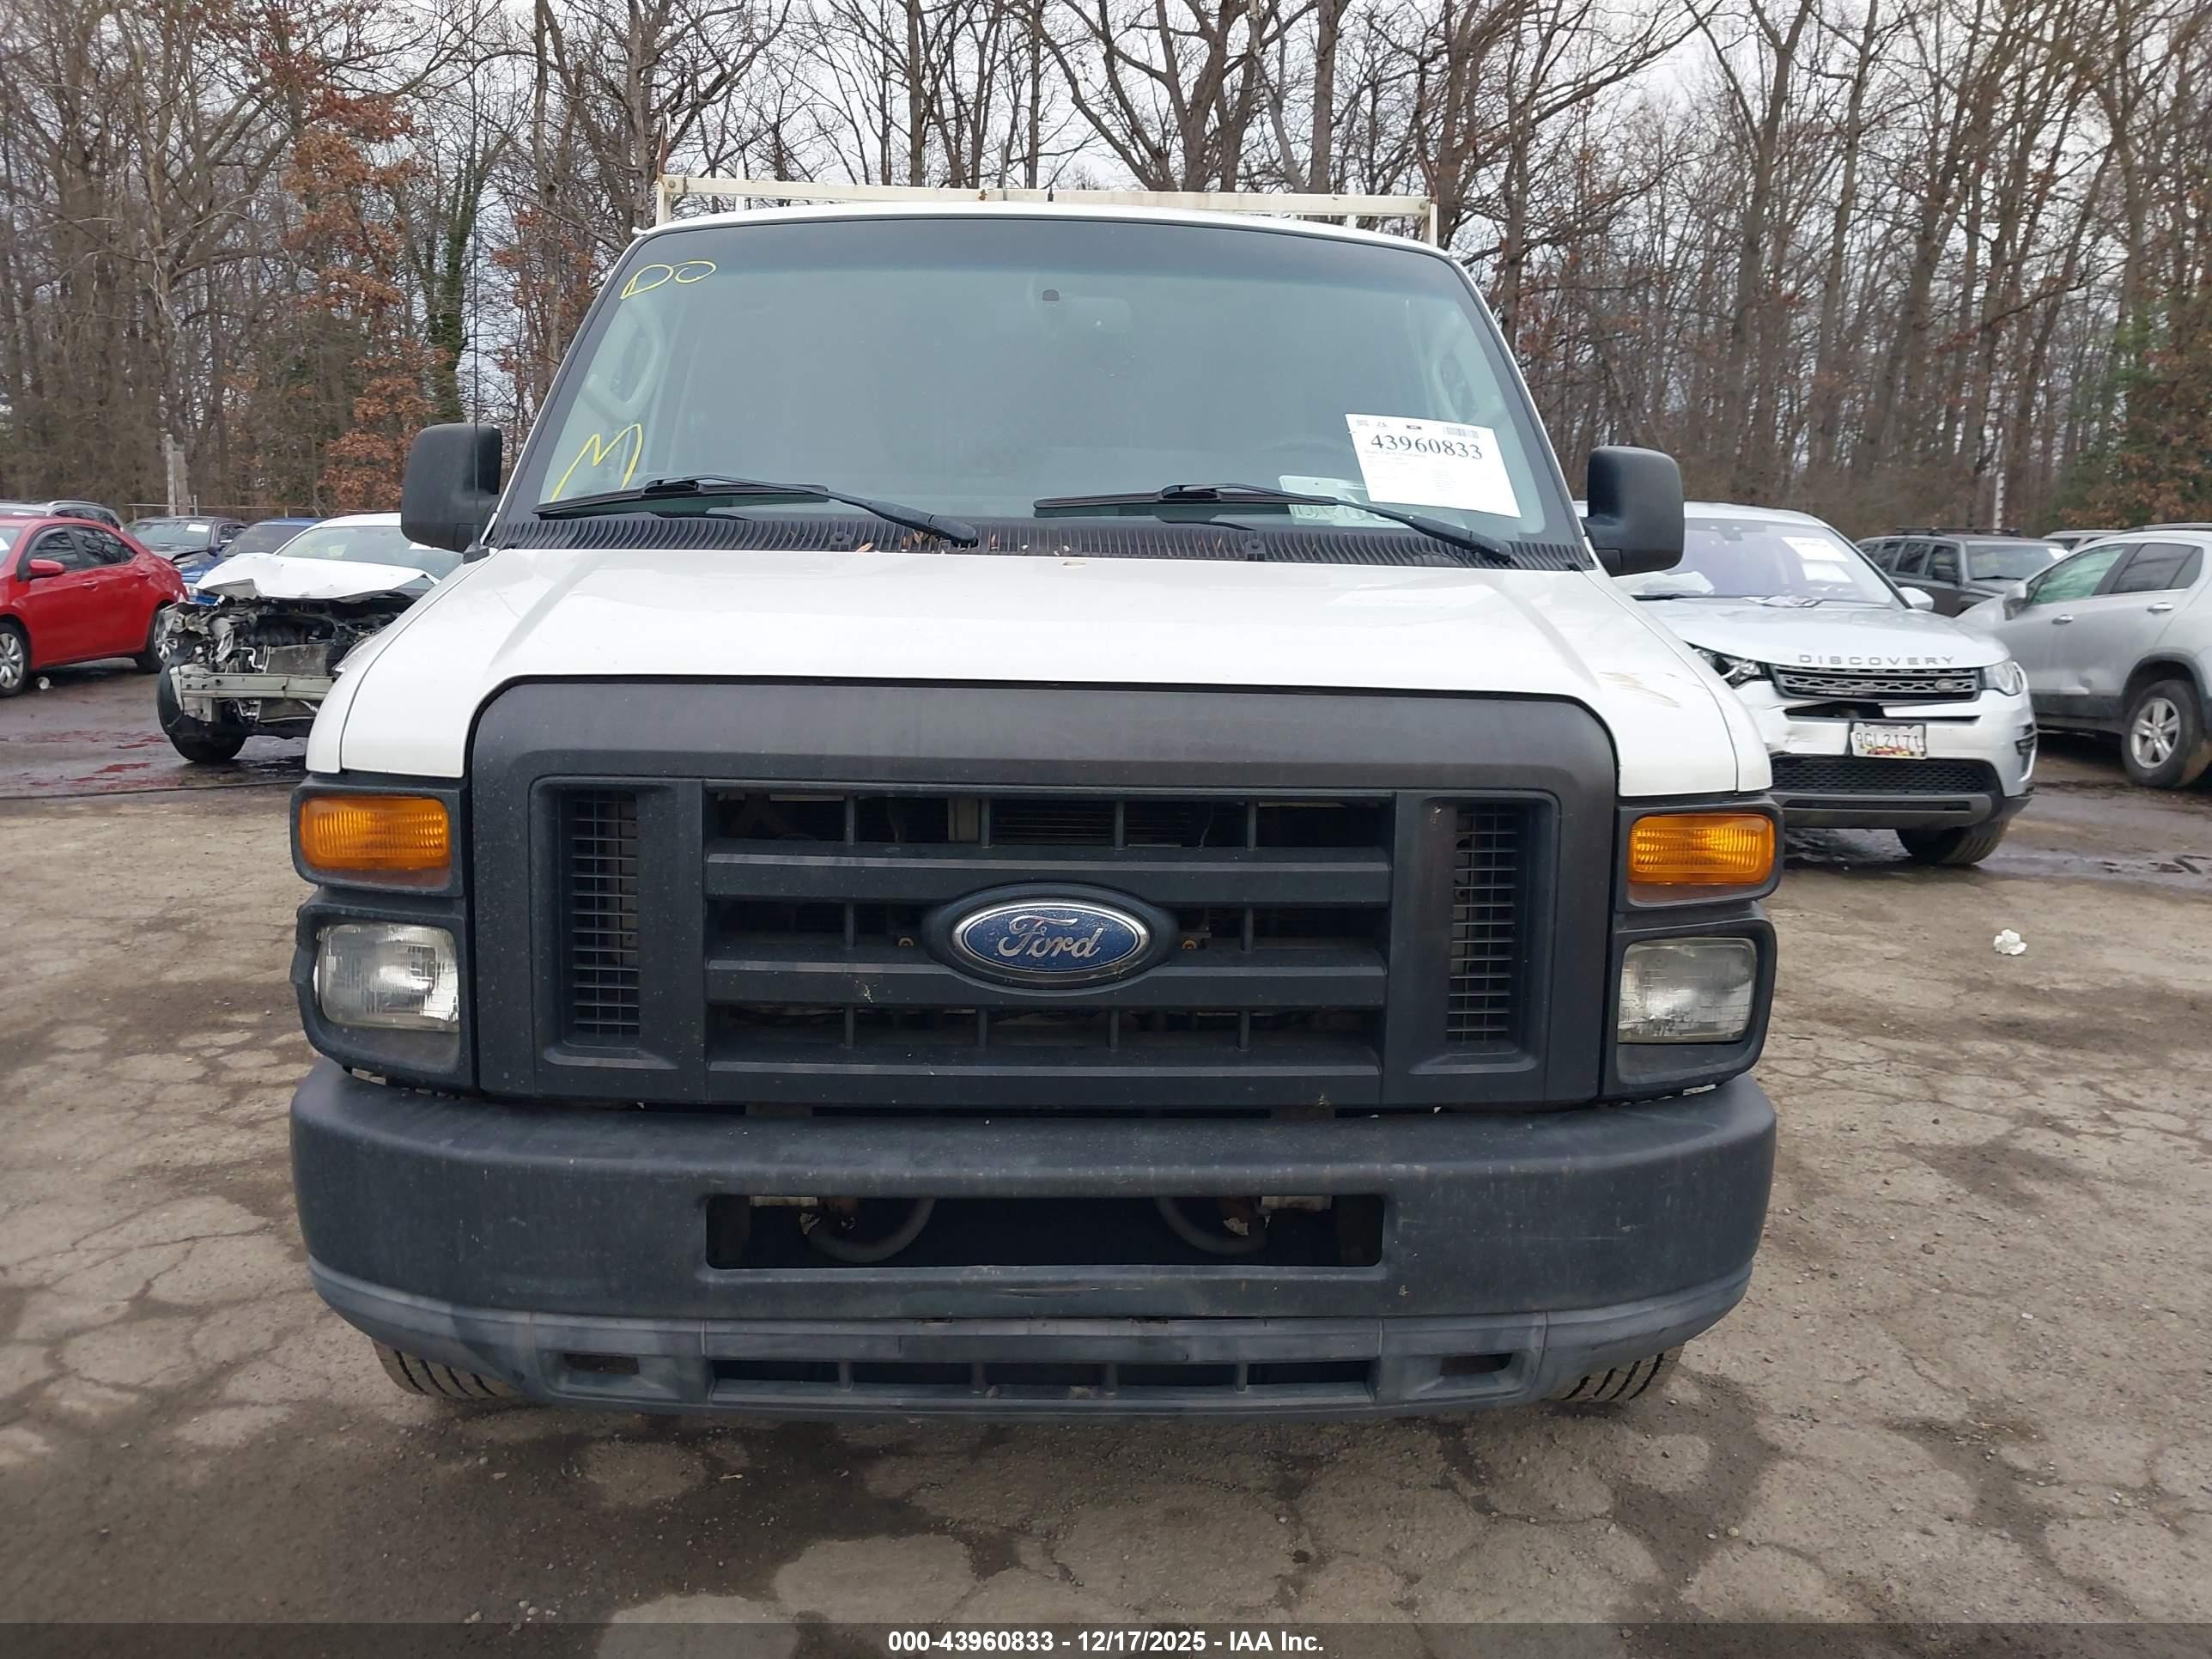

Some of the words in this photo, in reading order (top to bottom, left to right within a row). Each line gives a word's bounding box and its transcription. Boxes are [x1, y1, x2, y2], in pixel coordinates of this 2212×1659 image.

[550, 423, 643, 501] M
[1370, 433, 1483, 460] 43960833
[1798, 654, 1954, 665] DISCOVERY
[998, 915, 1104, 958] Ford
